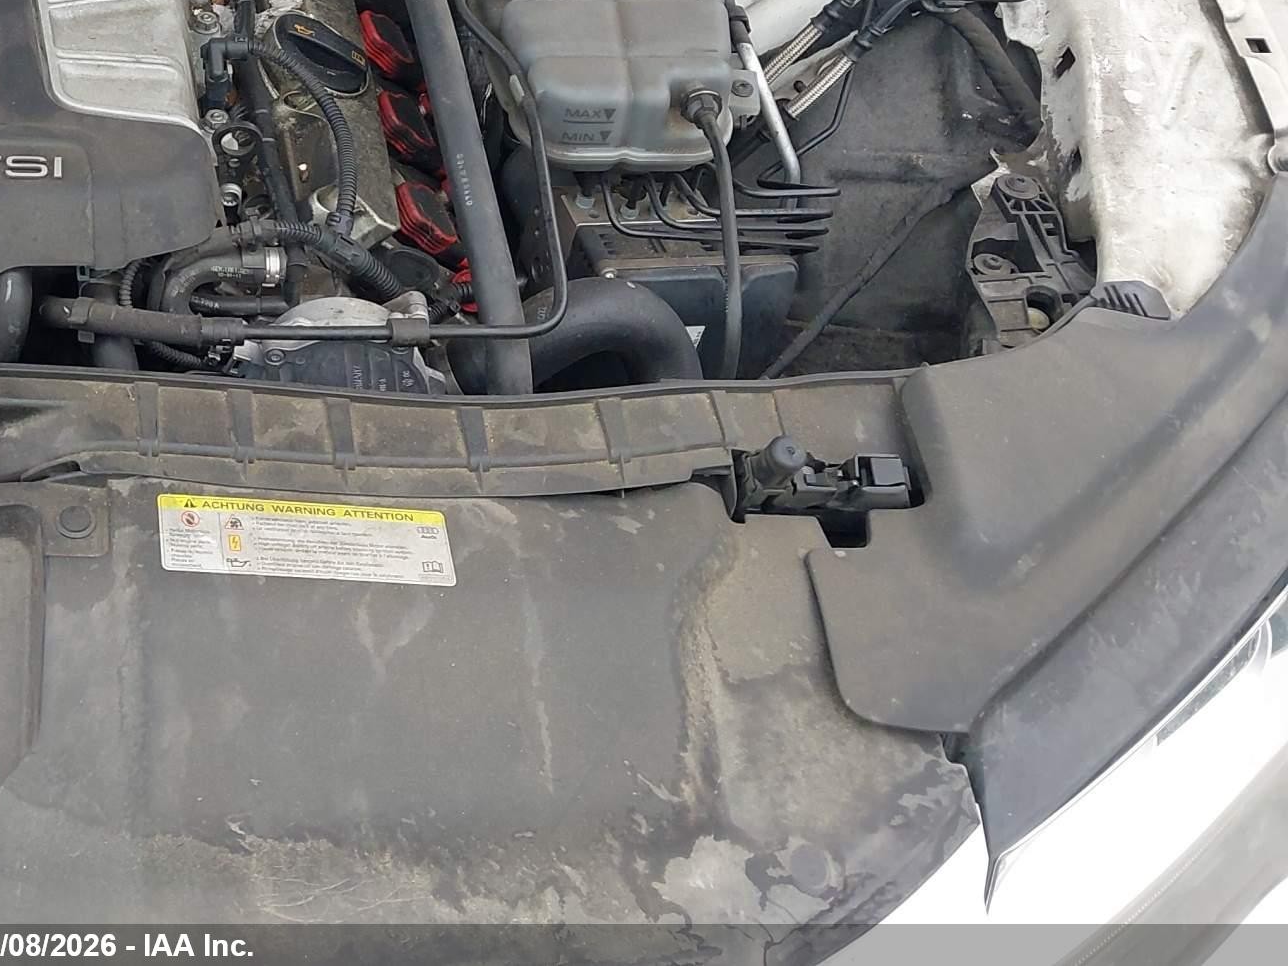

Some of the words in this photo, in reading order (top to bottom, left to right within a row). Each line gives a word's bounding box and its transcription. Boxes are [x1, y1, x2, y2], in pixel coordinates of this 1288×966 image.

[565, 108, 601, 118] MAX
[562, 132, 594, 141] MIN
[201, 500, 265, 513] ACHTUNG
[271, 504, 336, 517] WARNING
[343, 509, 414, 522] ATTENTION
